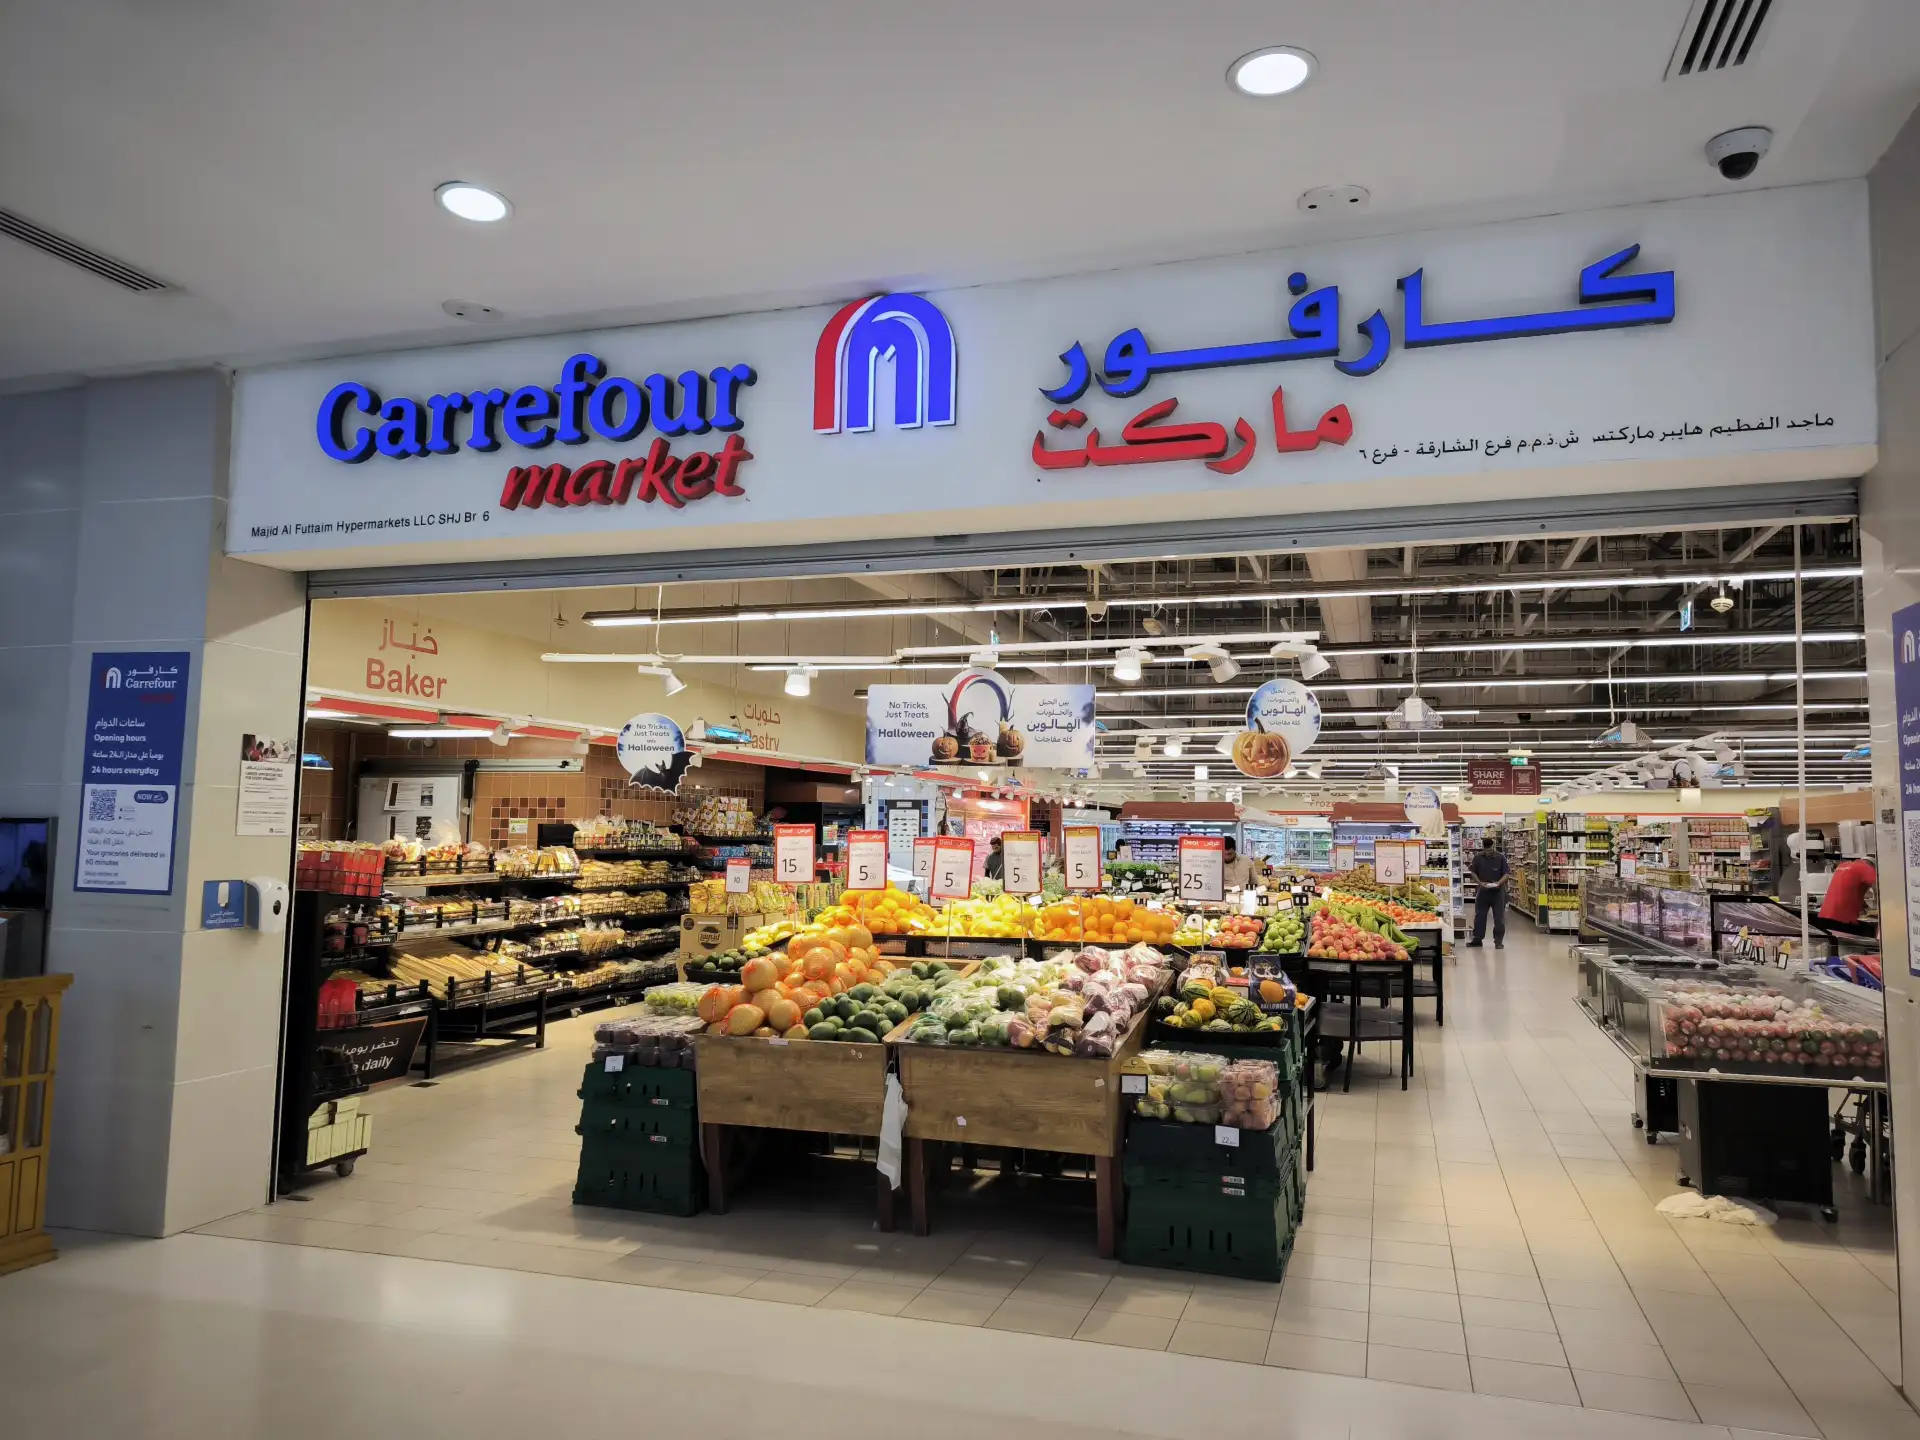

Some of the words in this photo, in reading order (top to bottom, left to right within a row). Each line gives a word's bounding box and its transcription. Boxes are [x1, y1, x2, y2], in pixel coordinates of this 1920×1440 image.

[1038, 243, 1675, 404] كارفور
[316, 353, 757, 464] Carrefour
[1032, 384, 1353, 475] ماركت
[1709, 415, 1780, 438] الفطيم
[1786, 412, 1834, 431] ماجد
[1659, 421, 1703, 442] هايبر
[1372, 442, 1398, 465] فرع
[1416, 438, 1480, 459] الشارقة
[1484, 435, 1512, 456] فرع
[499, 433, 755, 511] market
[251, 526, 279, 539] Majid
[281, 523, 292, 535] Al
[295, 522, 333, 535] Futtaim
[336, 515, 411, 534] Hypermarkets
[413, 514, 436, 526] LLC
[438, 512, 461, 524] SHJ
[464, 511, 477, 523] Br
[482, 510, 490, 522] 6
[125, 677, 177, 689] Carrefour
[366, 657, 447, 699] Baker
[903, 701, 928, 710] Tricks,
[95, 717, 118, 730] الدوام
[119, 717, 146, 727] ساعات
[1026, 719, 1080, 732] الهالوين
[94, 733, 125, 743] Opening
[126, 734, 146, 742] hours
[878, 728, 935, 738] Halloween
[91, 766, 101, 774] 24
[102, 766, 123, 774] hours
[124, 767, 159, 776] everyday
[101, 850, 129, 858] groceries
[130, 850, 158, 858] delivered
[782, 858, 797, 873] 15
[859, 865, 869, 881] 5
[1075, 863, 1084, 879] 5
[1385, 866, 1392, 877] 6
[945, 872, 954, 887] 5
[1013, 867, 1020, 883] 5
[1183, 873, 1203, 890] 25
[362, 1056, 394, 1071] daily
